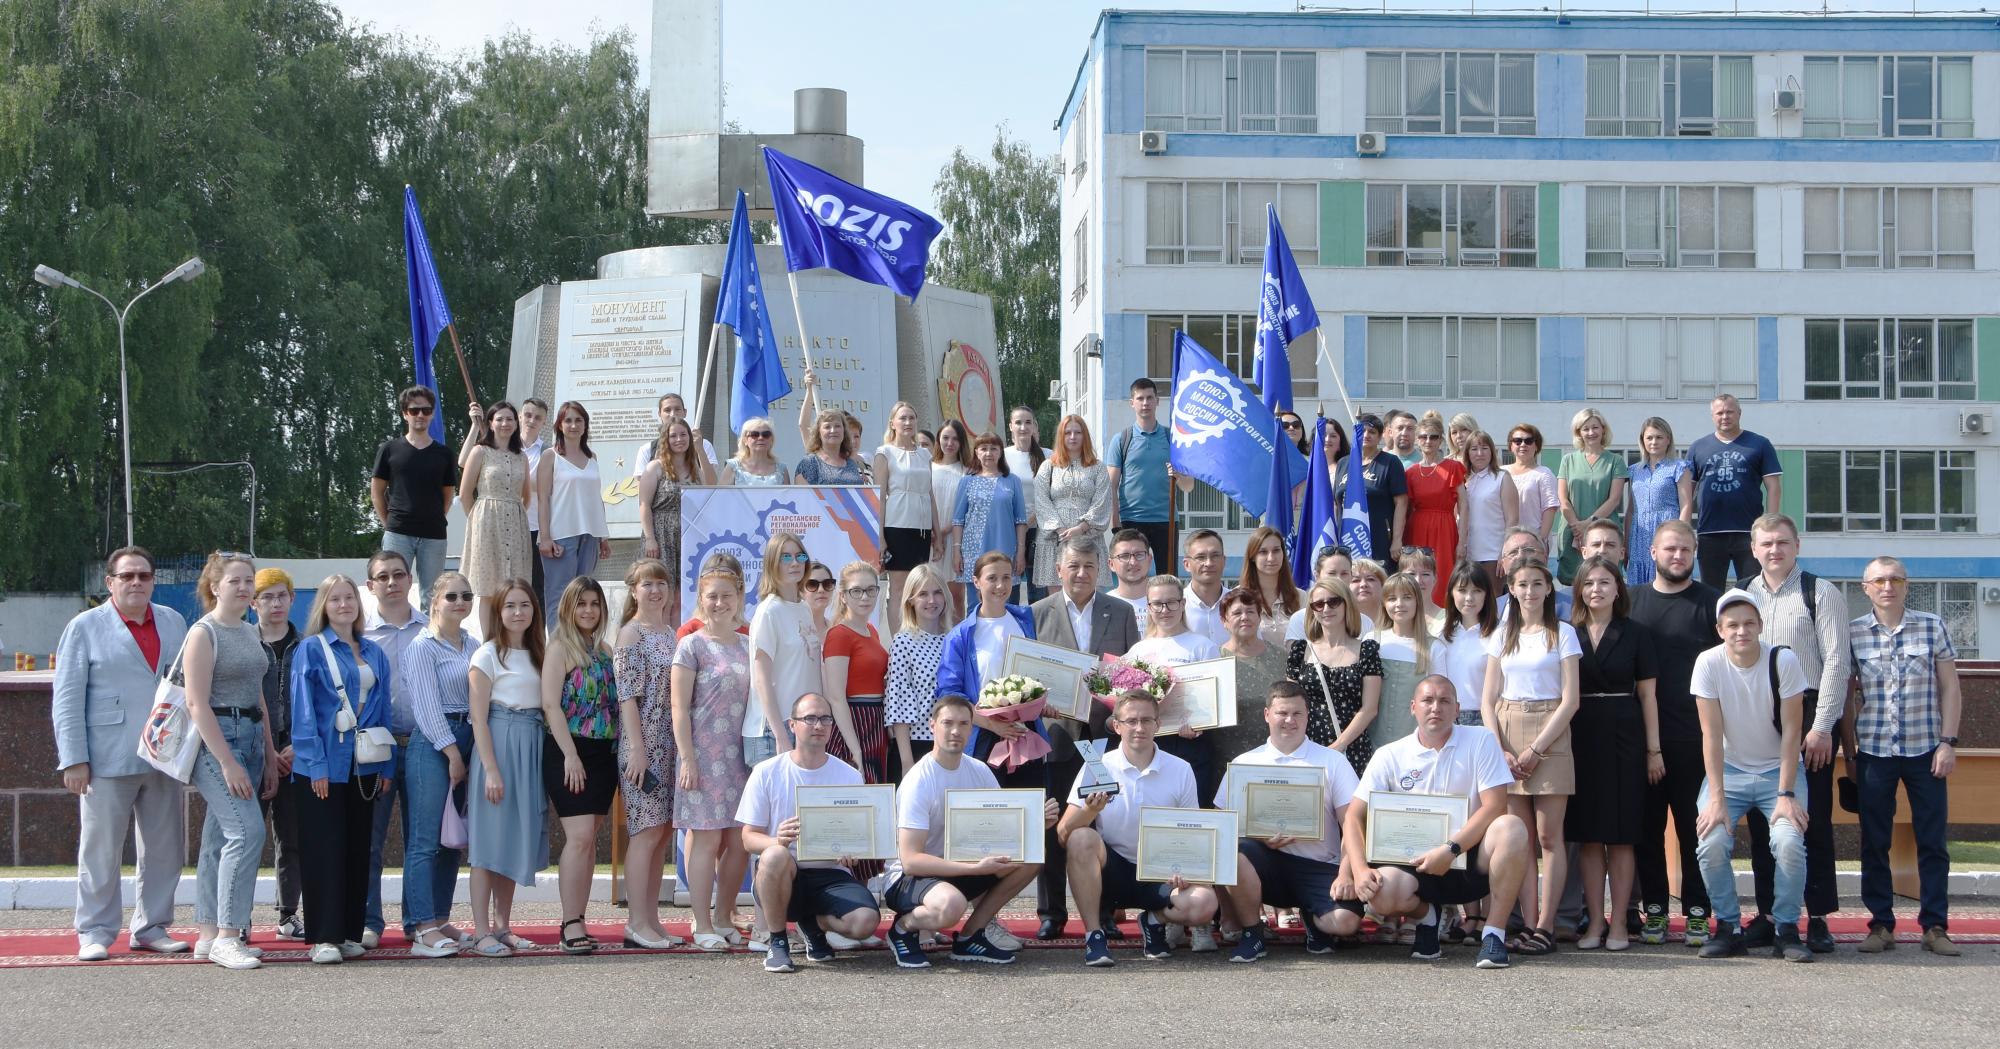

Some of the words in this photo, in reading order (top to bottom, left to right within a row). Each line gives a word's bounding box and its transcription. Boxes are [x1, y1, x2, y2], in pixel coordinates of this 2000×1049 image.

[797, 188, 913, 251] POZIS
[1266, 285, 1279, 306] СОЮЗ
[592, 300, 667, 316] МОНУМЕНТ
[1198, 381, 1228, 401] СОЮЗ
[1183, 402, 1219, 424] РОССИИ
[1190, 391, 1275, 456] МАШИНОСТРОИТЕЛ
[1717, 467, 1734, 481] 95
[1711, 480, 1741, 492] CLUB
